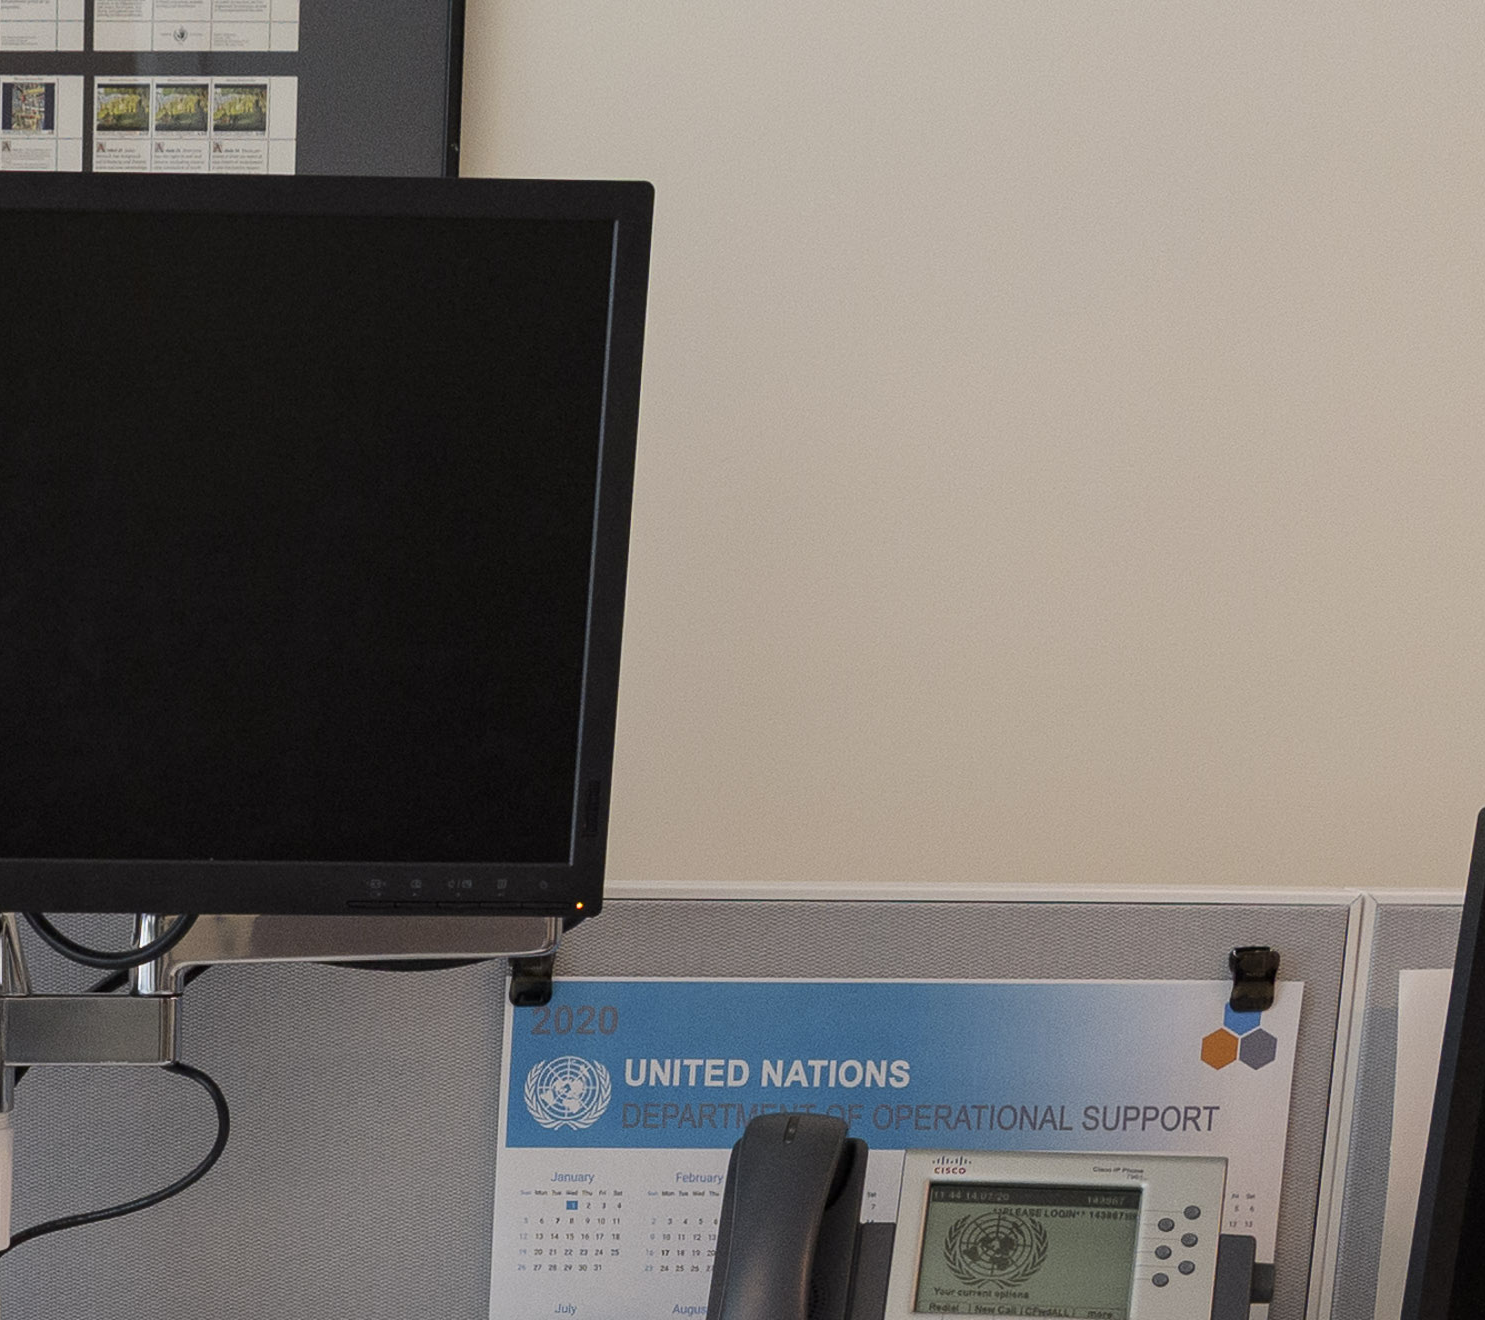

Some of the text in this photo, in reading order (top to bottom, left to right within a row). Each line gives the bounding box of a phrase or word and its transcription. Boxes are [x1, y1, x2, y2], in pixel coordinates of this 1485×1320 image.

[531, 1005, 618, 1035] 2020
[624, 1059, 910, 1088] UNITED NATIONS
[873, 1104, 1074, 1131] OPERATIONAL
[1081, 1105, 1220, 1132] SUPPORT
[934, 1167, 966, 1175] CISCO
[550, 1172, 595, 1184] January
[676, 1172, 724, 1184] February
[934, 1287, 1029, 1300] Your current options
[554, 1304, 577, 1316] July
[672, 1304, 707, 1316] Augus
[929, 1303, 959, 1312] Redial
[975, 1305, 995, 1314] New
[1088, 1310, 1113, 1319] more
